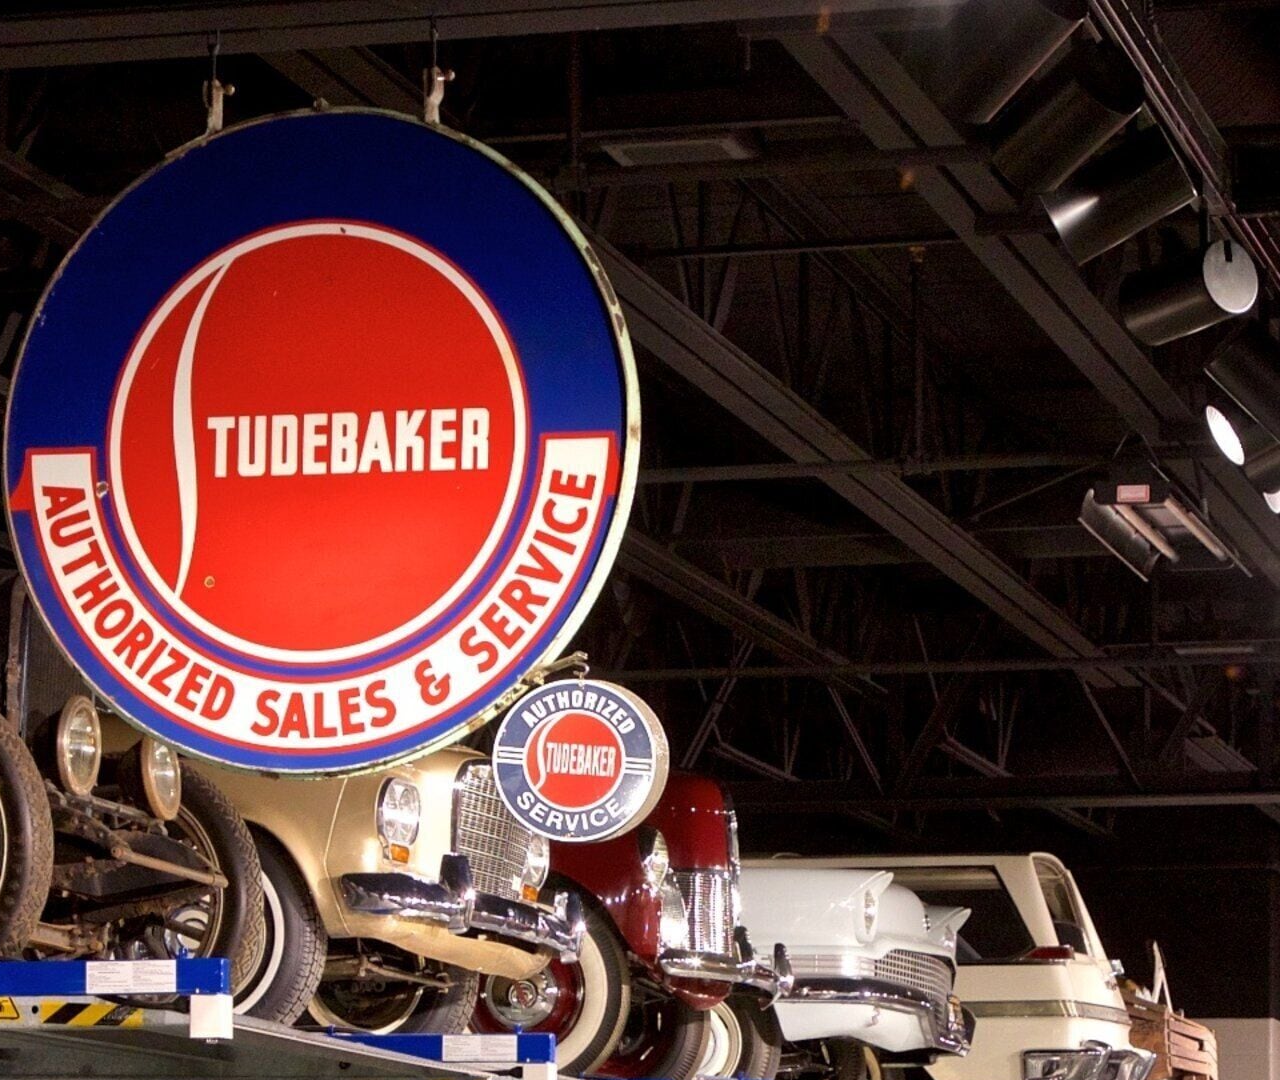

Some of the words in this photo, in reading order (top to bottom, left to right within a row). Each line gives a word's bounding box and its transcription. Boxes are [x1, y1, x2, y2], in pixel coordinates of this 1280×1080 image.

[42, 485, 235, 721] AUTHORIZED
[251, 680, 397, 739] SALES
[417, 660, 451, 705] &
[460, 469, 597, 673] SERVICE
[521, 690, 635, 734] AUTHORIZED
[517, 791, 625, 831] SERVICE
